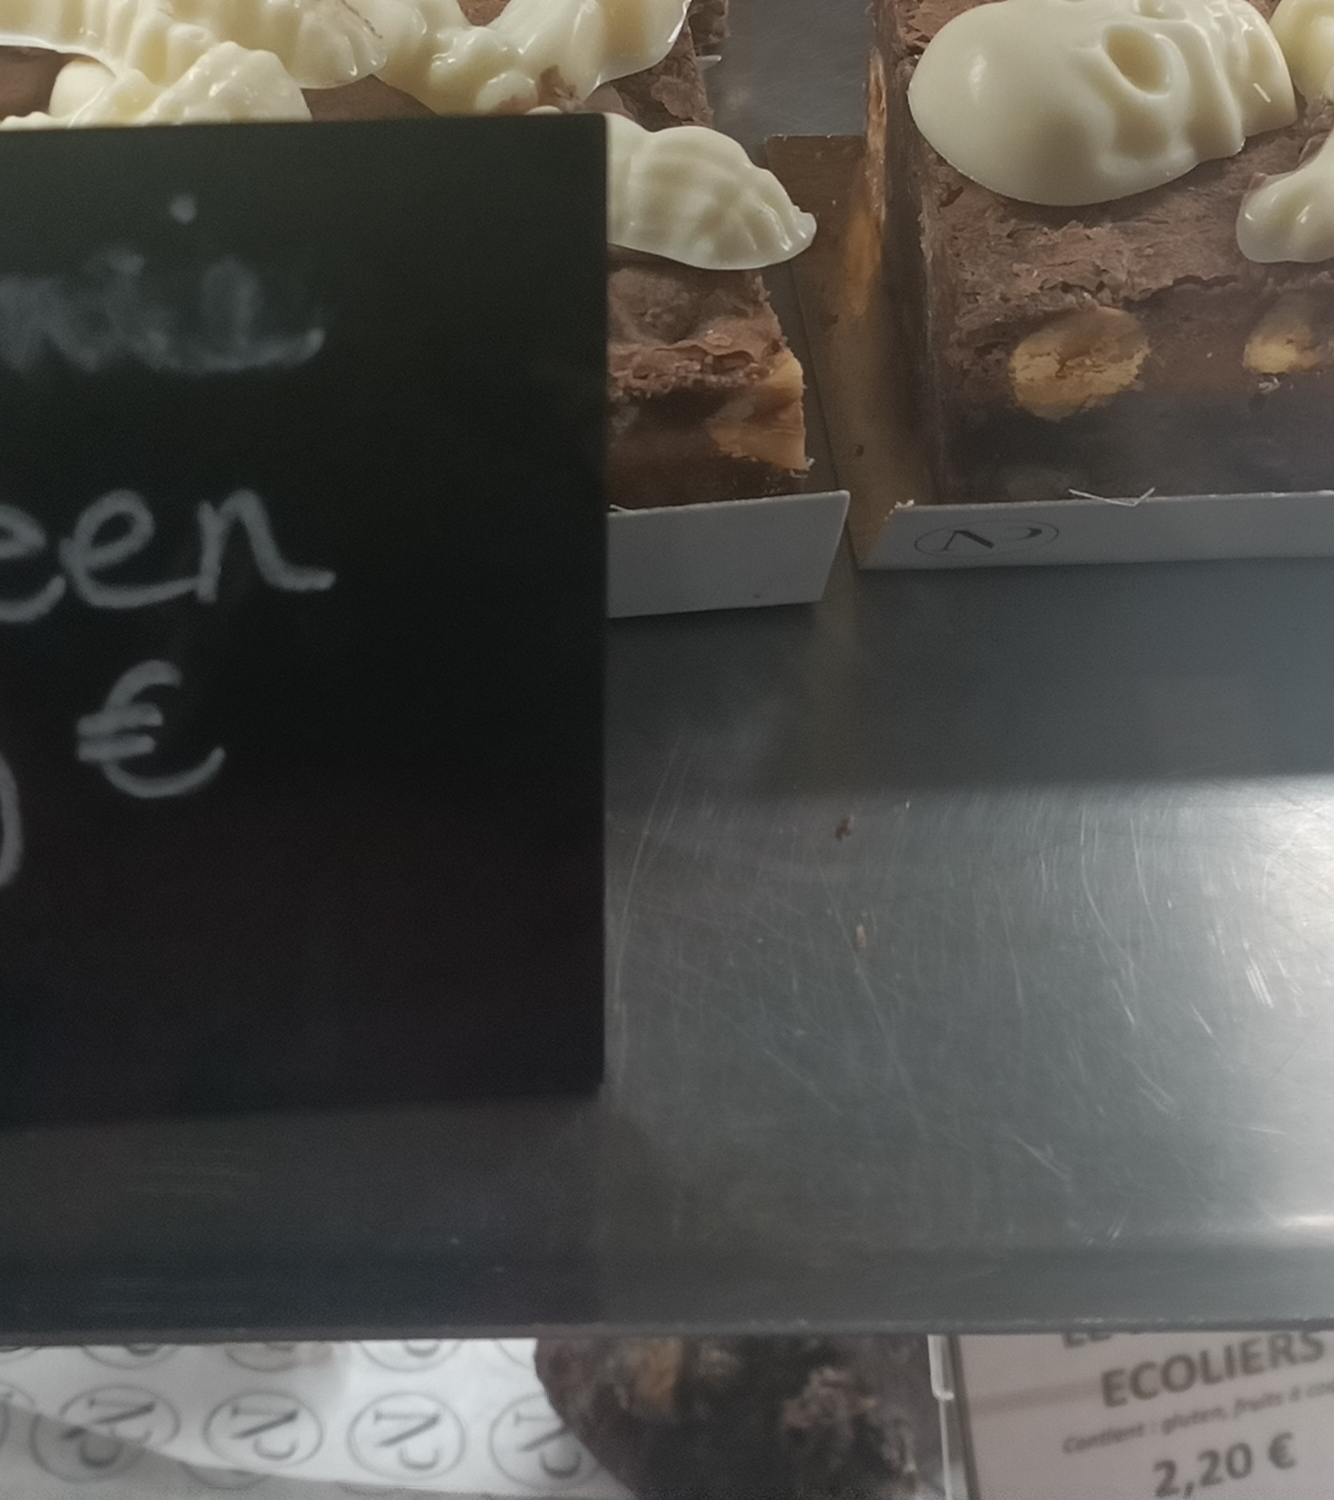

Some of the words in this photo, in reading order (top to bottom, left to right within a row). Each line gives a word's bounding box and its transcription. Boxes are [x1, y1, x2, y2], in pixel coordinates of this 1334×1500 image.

[1100, 1332, 1328, 1409] ECOLIERS
[1152, 1441, 1253, 1499] 2,20
[1267, 1431, 1298, 1471] €
